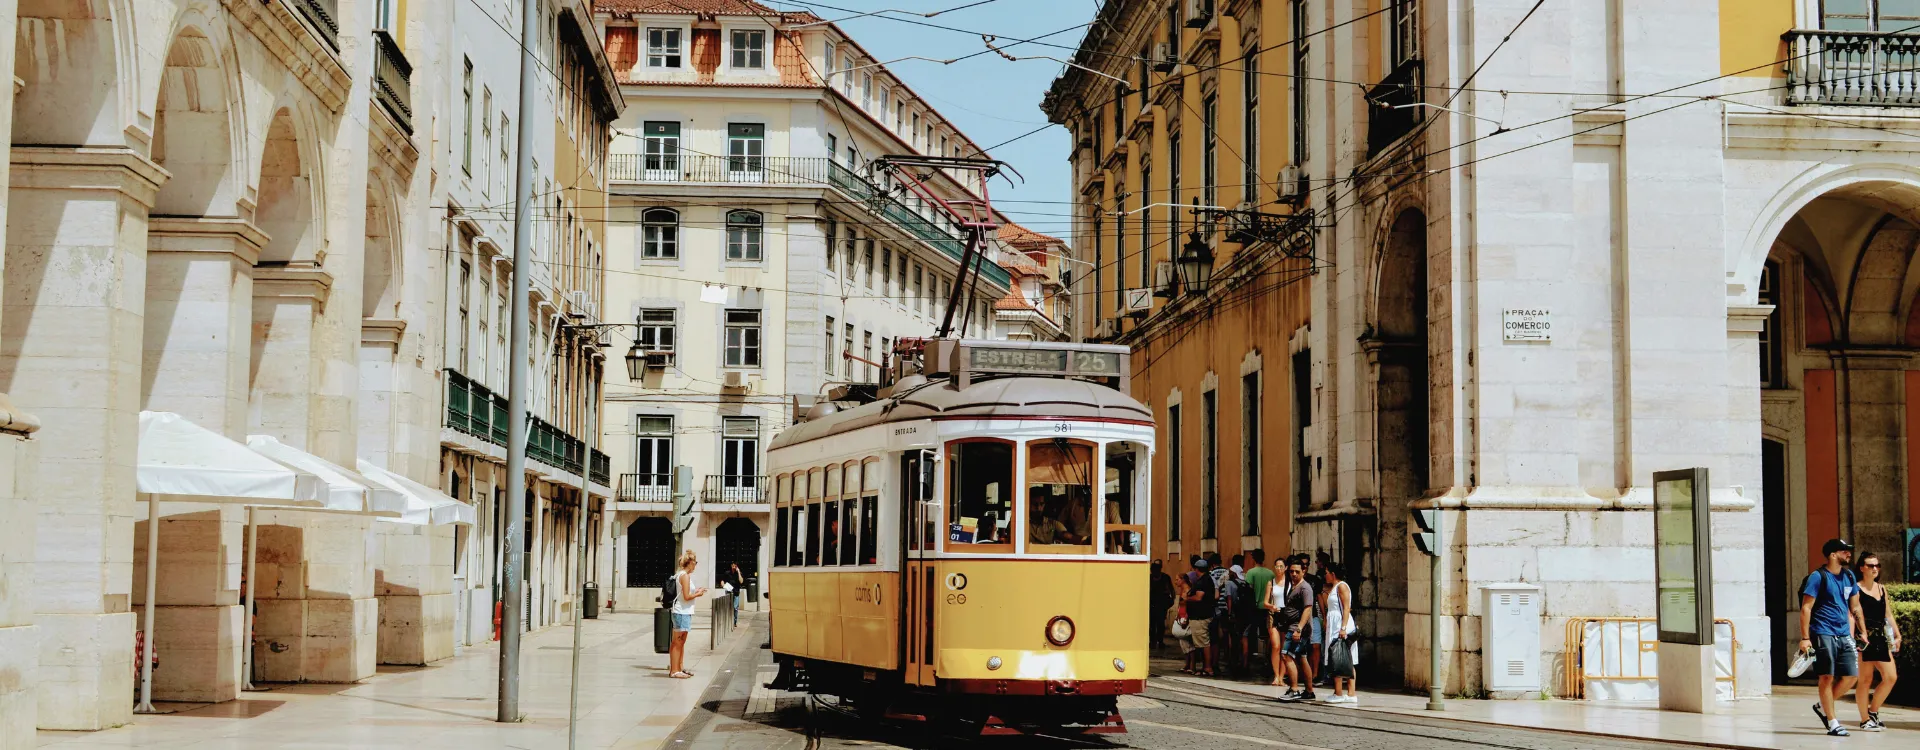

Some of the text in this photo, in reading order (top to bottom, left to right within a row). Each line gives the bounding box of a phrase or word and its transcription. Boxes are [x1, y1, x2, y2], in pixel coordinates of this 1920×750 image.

[1512, 310, 1544, 318] PRAÇA
[1505, 321, 1551, 329] COMERCIO
[976, 350, 1106, 372] ESTRELA 25
[895, 427, 917, 436] ENTRADA
[1054, 423, 1072, 433] 581
[950, 533, 960, 541] 01
